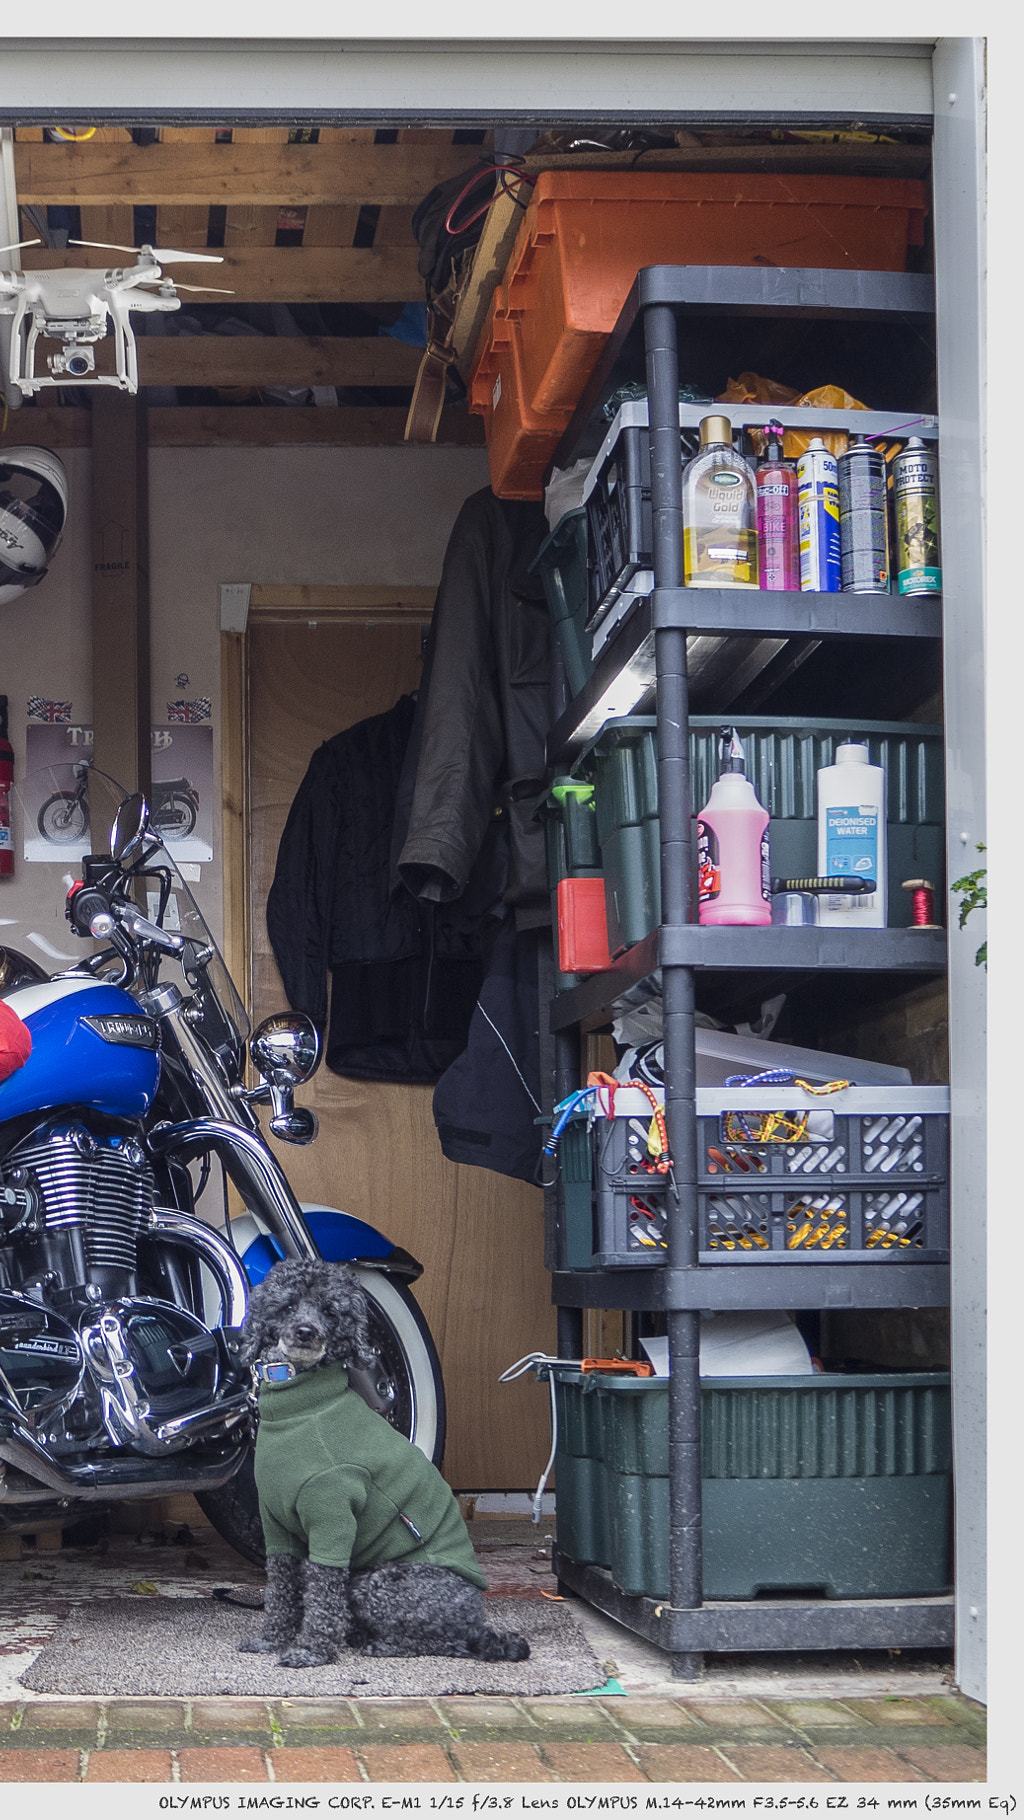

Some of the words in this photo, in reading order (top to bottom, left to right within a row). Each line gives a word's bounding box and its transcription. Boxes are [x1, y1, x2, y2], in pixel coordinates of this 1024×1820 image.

[899, 463, 928, 475] MOTO
[896, 473, 935, 487] PROTECT
[708, 487, 744, 502] Liquid
[713, 502, 739, 513] Gold
[763, 522, 786, 532] BIKE
[94, 561, 130, 571] FRAGILE
[902, 575, 936, 586] MOTOREX
[828, 817, 876, 827] DEIONISED
[836, 826, 868, 835] WATER
